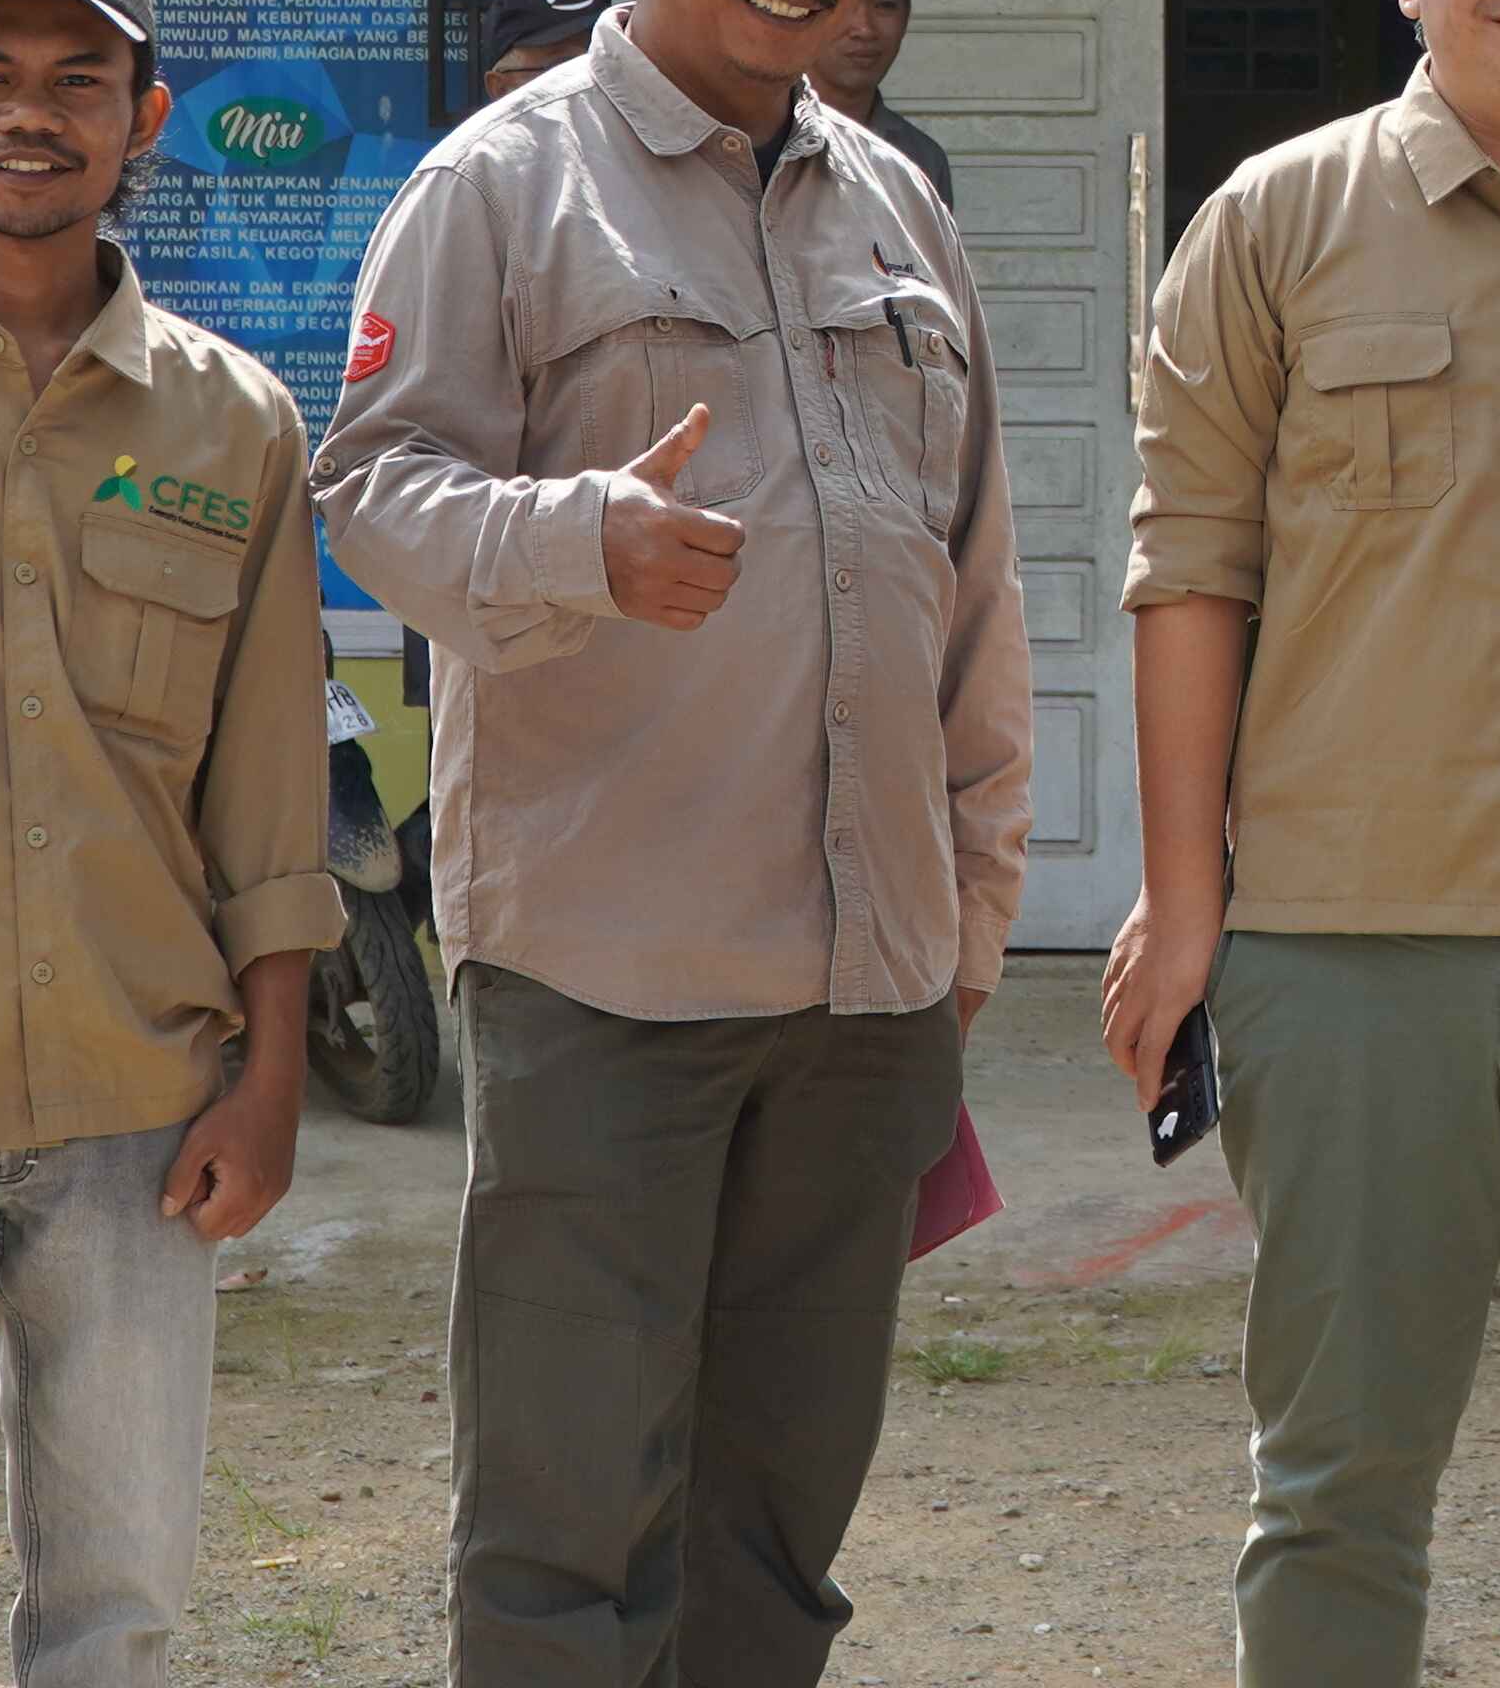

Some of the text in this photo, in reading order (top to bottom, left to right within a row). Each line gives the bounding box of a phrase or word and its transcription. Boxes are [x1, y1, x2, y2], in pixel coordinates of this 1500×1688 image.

[153, 10, 247, 25] EMENUHAN
[257, 11, 361, 25] KEBUTUHAN
[237, 28, 346, 43] MASYARAKAT
[355, 30, 398, 44] YANG
[161, 46, 209, 61] MAJU,
[211, 47, 280, 61] MANDIRI,
[284, 47, 356, 61] BAHAGIA
[357, 48, 390, 62] DAN
[221, 105, 308, 159] Misi
[192, 175, 321, 191] MEMANTAPKAN
[205, 194, 265, 208] UNTUK
[275, 194, 390, 209] MENDORONG
[190, 210, 206, 224] DI
[145, 228, 231, 242] KARAKTER
[237, 229, 325, 243] KELUARGA
[141, 281, 241, 295] PENDIDIKAN
[250, 282, 284, 295] DAN
[222, 299, 302, 313] BERBAGAI
[149, 475, 251, 530] CFES
